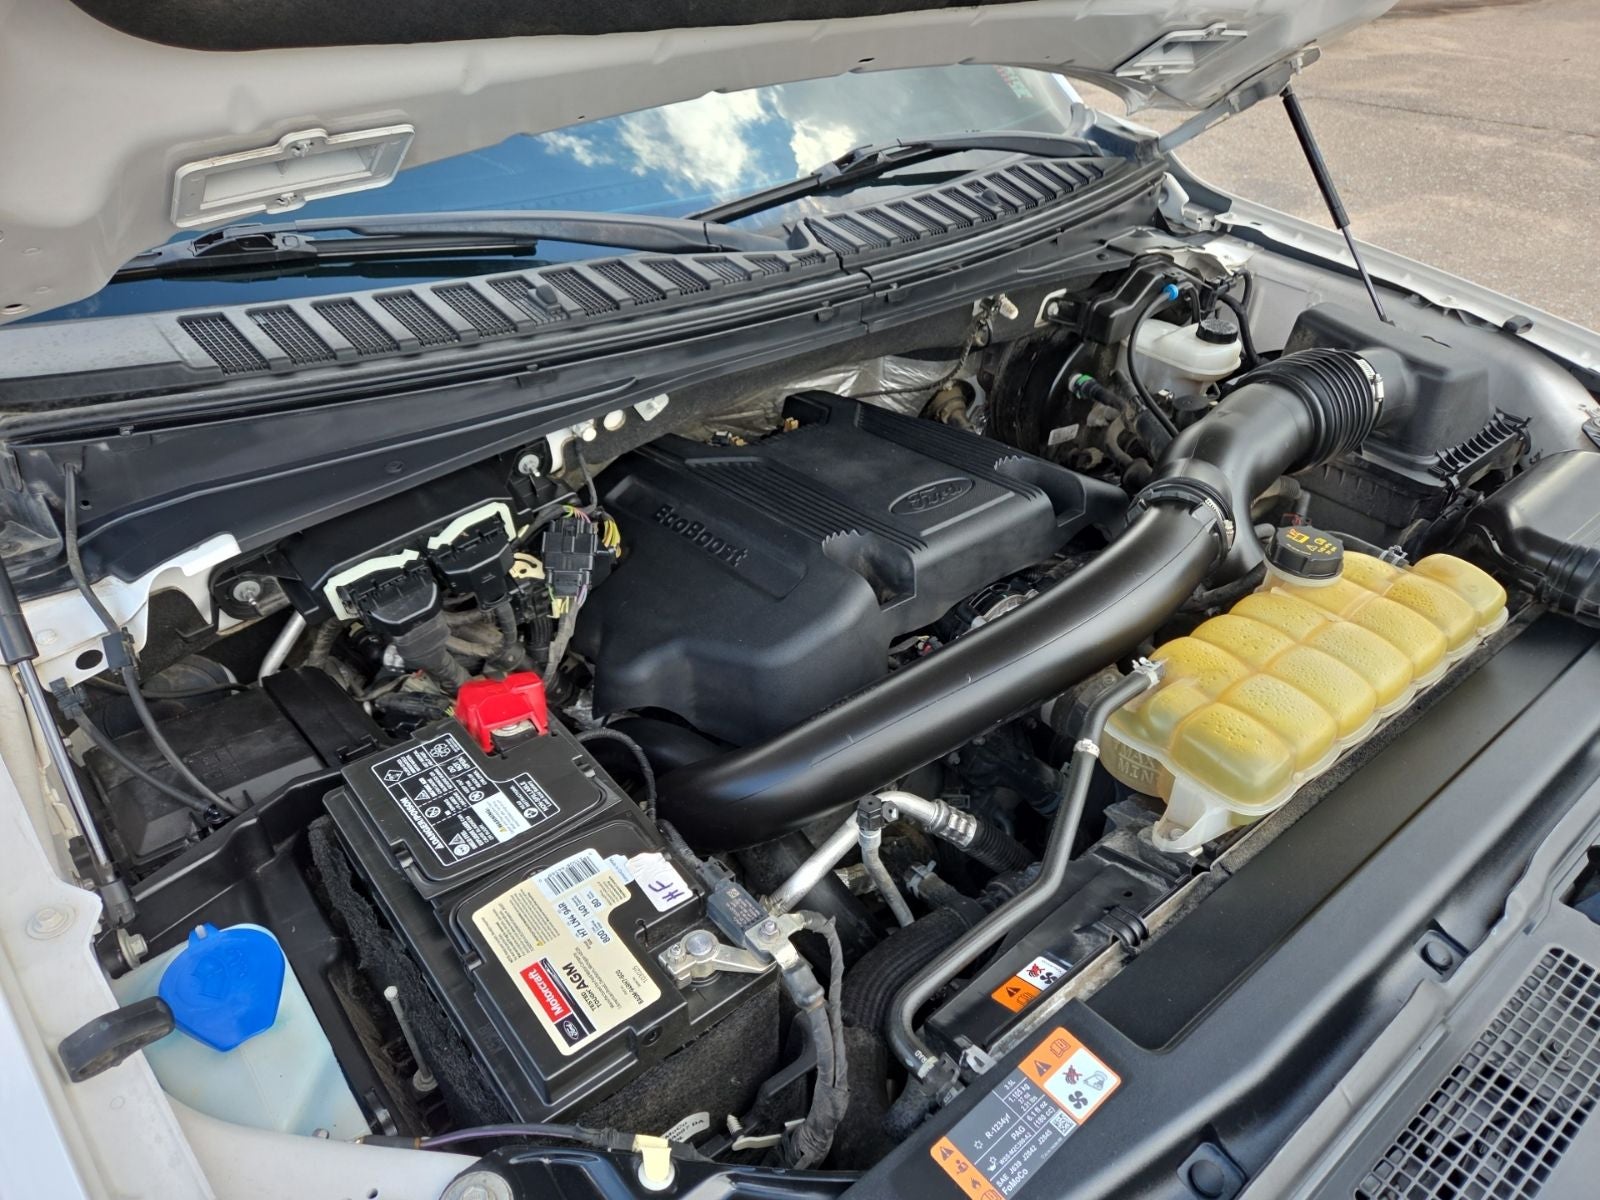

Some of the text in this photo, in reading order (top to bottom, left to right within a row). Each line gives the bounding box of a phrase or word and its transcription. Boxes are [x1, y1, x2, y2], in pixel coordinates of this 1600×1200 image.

[653, 503, 749, 567] EcoBoost
[1118, 758, 1154, 784] MIN
[518, 780, 549, 811] NON-SPILLABLE
[399, 796, 441, 845] DANGER/POISON
[557, 900, 572, 916] 94R
[577, 903, 590, 917] 140
[590, 896, 602, 909] 80
[566, 912, 581, 929] LN4
[575, 925, 588, 938] H7
[596, 928, 611, 944] 800
[526, 968, 564, 1016] Motorcraft
[561, 960, 597, 1012] TESTED AGM
[561, 1019, 580, 1040] Ford
[1019, 1081, 1031, 1093] kg
[1028, 1093, 1038, 1104] lbs
[1038, 1099, 1048, 1109] oz
[1043, 1104, 1056, 1118] cc)
[983, 1111, 1013, 1141] R-1234yf
[1009, 1124, 1026, 1141] PAG
[994, 1172, 1010, 1188] SAE
[1000, 1165, 1029, 1195] FoMoCo
